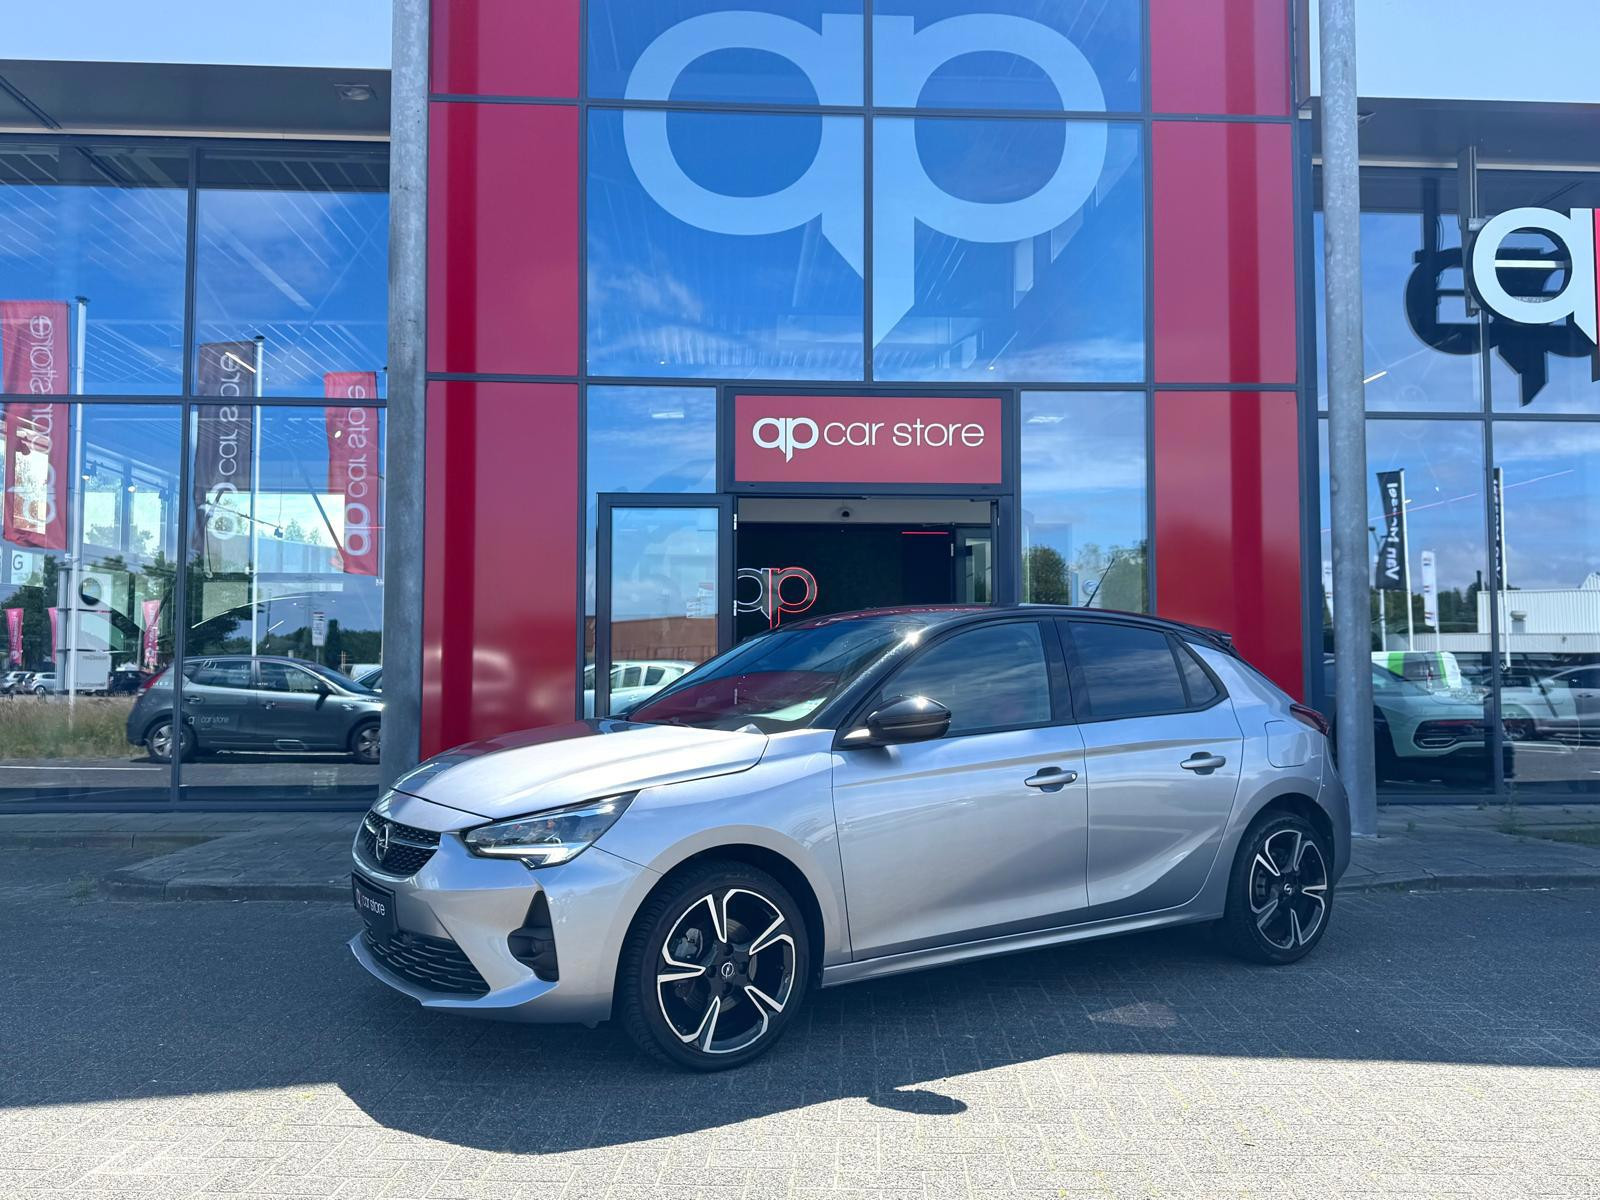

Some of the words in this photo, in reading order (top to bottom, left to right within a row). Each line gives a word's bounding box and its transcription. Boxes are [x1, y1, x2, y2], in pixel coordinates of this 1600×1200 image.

[623, 10, 1108, 349] ap
[1473, 207, 1600, 350] a
[752, 417, 819, 463] ap
[824, 422, 884, 446] car
[892, 418, 984, 447] store
[370, 898, 385, 916] store
